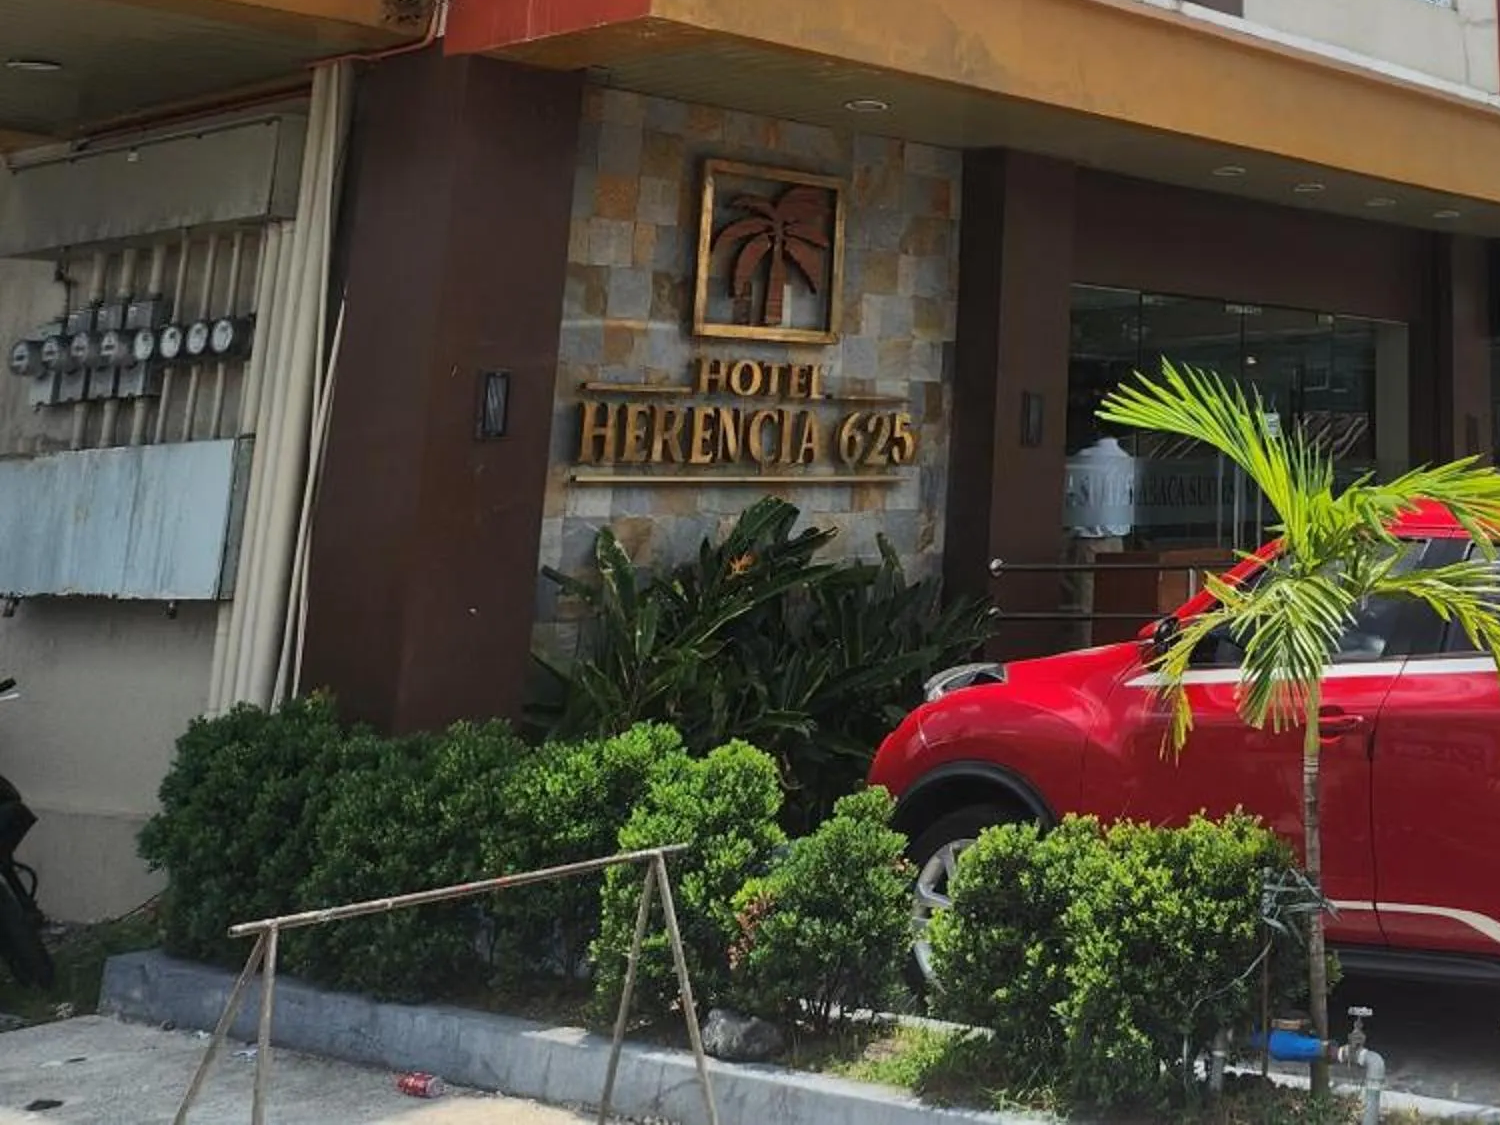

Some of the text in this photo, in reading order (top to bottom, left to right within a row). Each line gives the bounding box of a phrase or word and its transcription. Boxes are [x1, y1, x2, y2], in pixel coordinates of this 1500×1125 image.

[699, 359, 828, 399] HOTEL
[578, 402, 916, 467] HERENCIA 625
